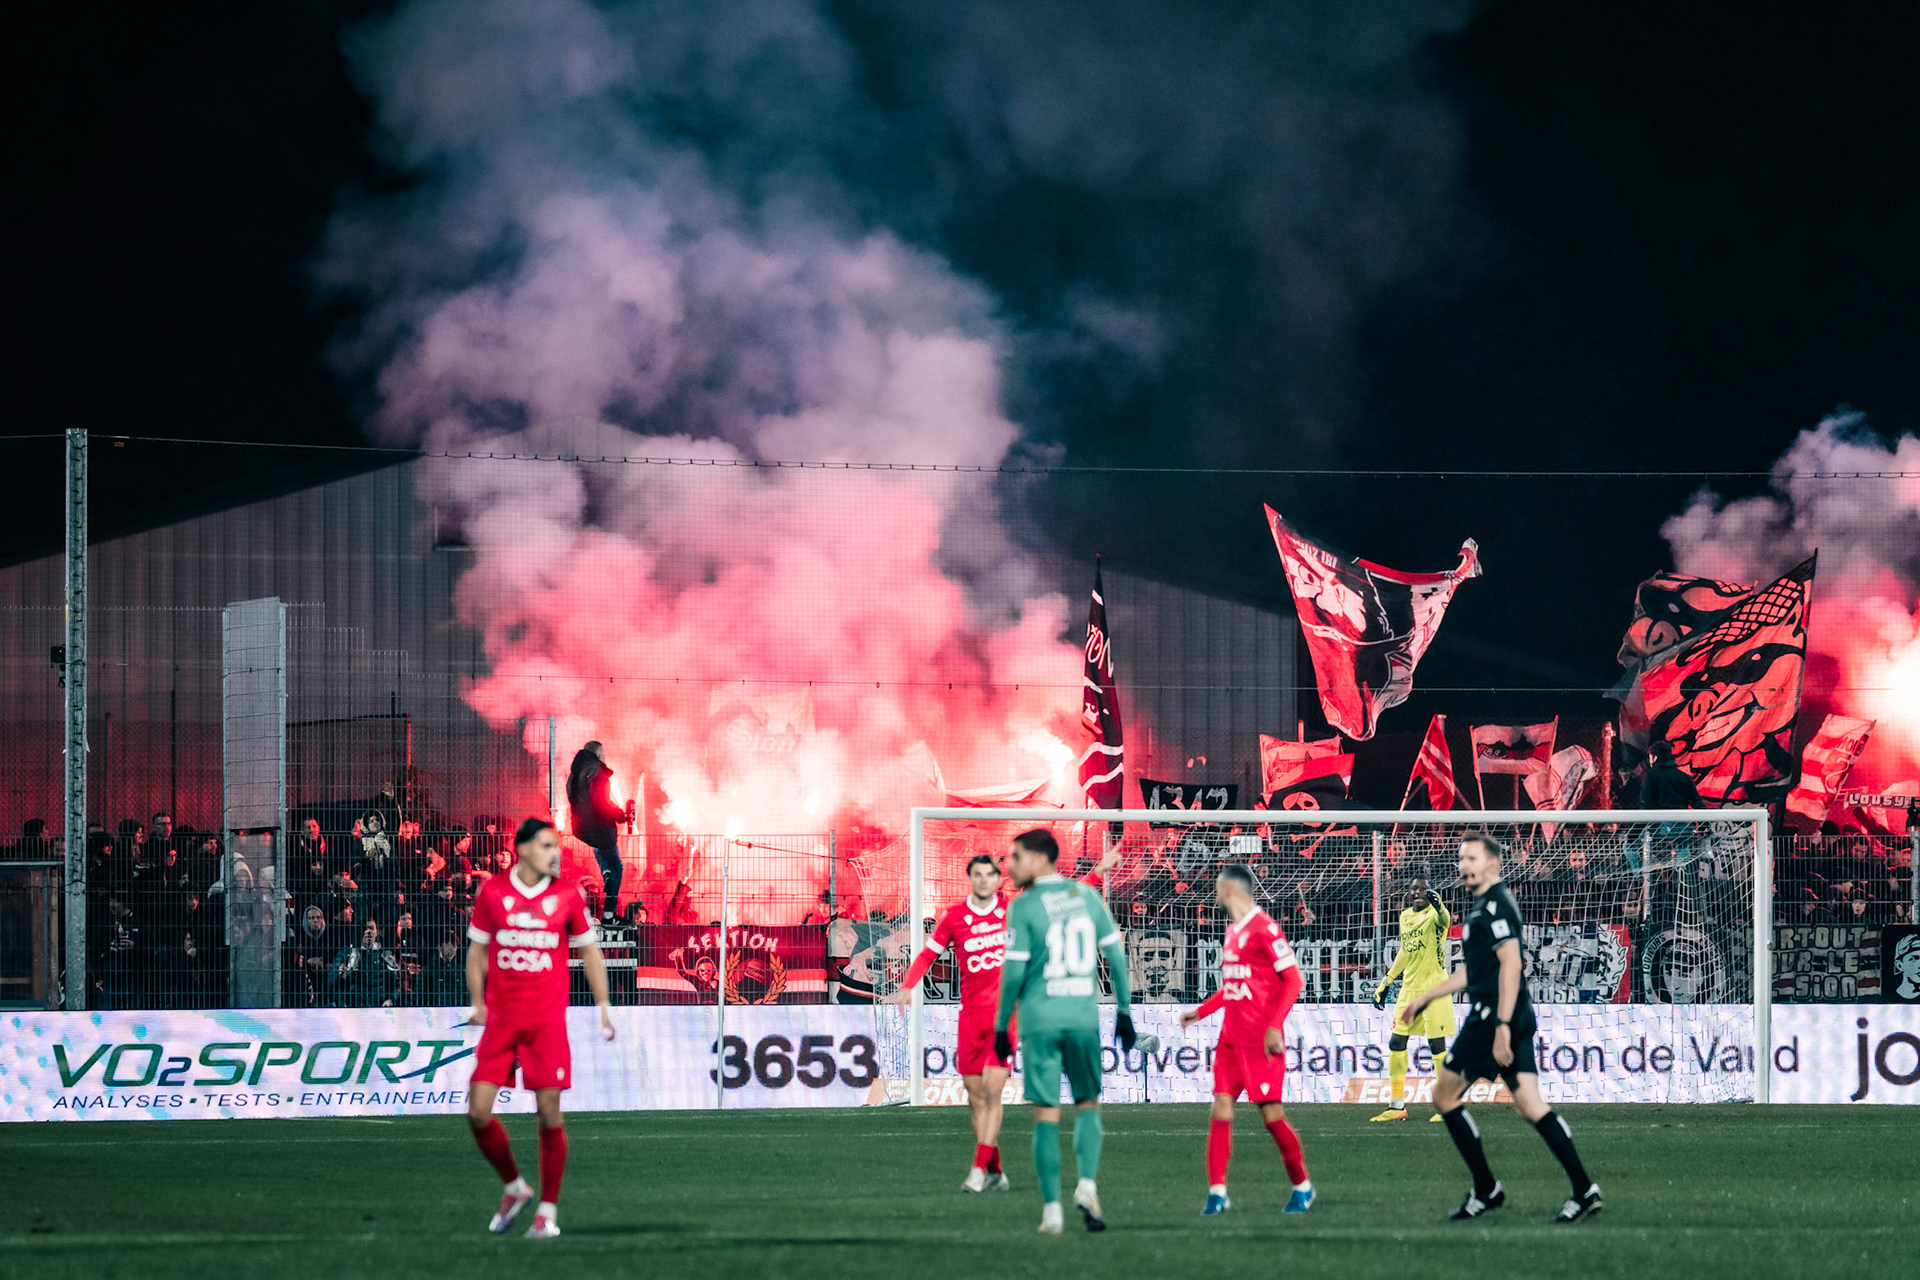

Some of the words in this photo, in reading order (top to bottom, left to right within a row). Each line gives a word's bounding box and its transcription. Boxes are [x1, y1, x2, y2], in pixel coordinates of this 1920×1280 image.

[967, 949, 1005, 973] CCS
[1044, 915, 1096, 980] 10
[1827, 951, 1859, 974] LE
[710, 1034, 880, 1089] 3653
[1284, 1037, 1384, 1073] dans
[1536, 1036, 1605, 1073] ton
[1622, 1036, 1675, 1073] de
[53, 1094, 183, 1109] ANALYSES
[204, 1092, 280, 1107] TESTS
[300, 1090, 512, 1106] ENTRAINEMES
